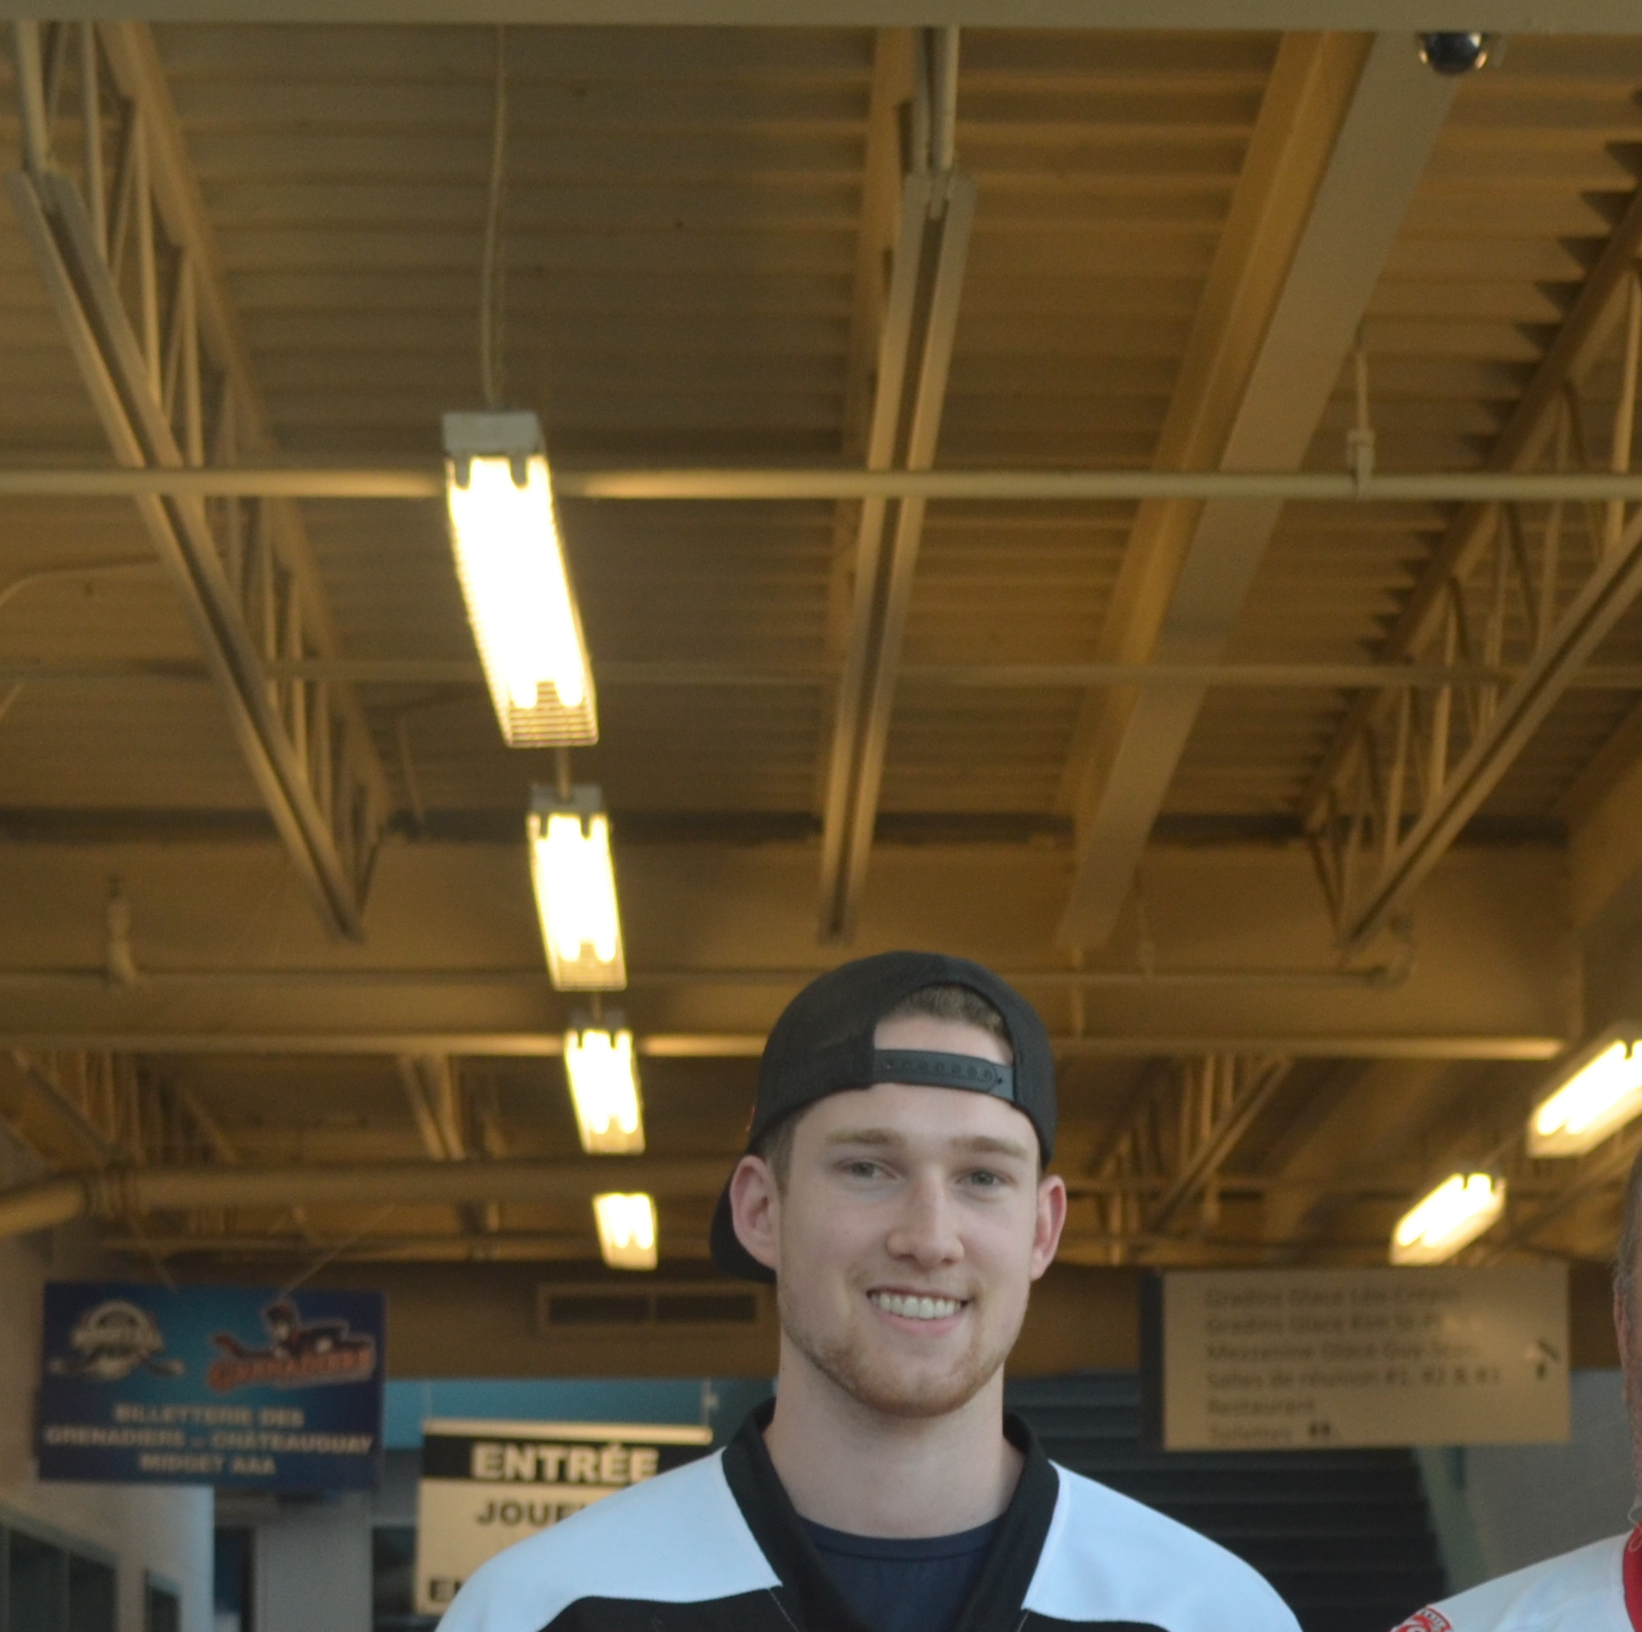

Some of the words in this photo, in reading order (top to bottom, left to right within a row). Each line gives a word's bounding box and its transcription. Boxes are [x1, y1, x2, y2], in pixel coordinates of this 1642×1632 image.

[114, 1403, 253, 1427] BILLETTERIE
[259, 1407, 305, 1428] DES
[45, 1426, 186, 1448] GRENADIERS
[471, 1441, 659, 1484] ENTRÉE
